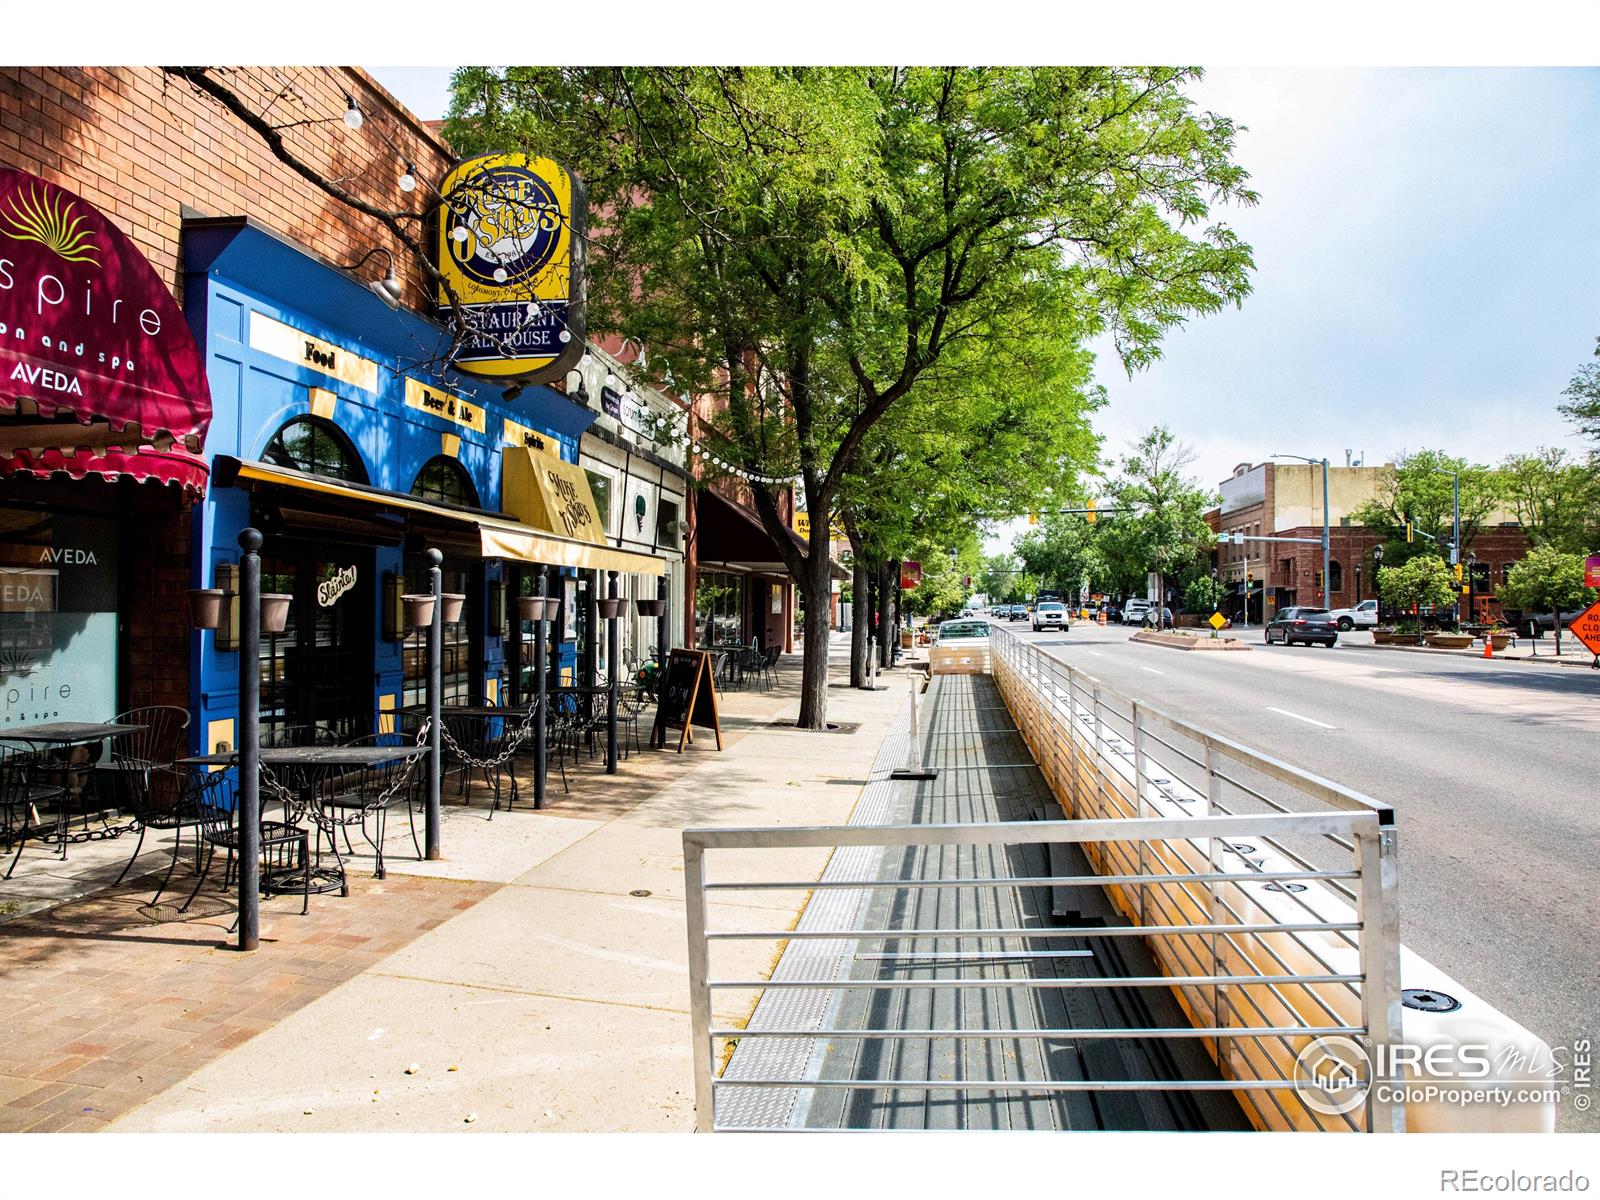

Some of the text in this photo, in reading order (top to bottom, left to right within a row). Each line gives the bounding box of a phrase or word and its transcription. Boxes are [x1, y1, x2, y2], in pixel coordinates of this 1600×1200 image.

[447, 311, 557, 333] RSTAURANT
[503, 330, 552, 347] HOUSE
[42, 335, 84, 356] and
[98, 352, 135, 371] spa
[304, 340, 336, 370] Food
[10, 361, 83, 397] AVEDA
[423, 389, 473, 423] Beer & Ale
[523, 431, 545, 451] Spirits
[40, 548, 97, 565] AVEDA
[0, 585, 44, 602] EDA
[1582, 623, 1600, 632] CLO
